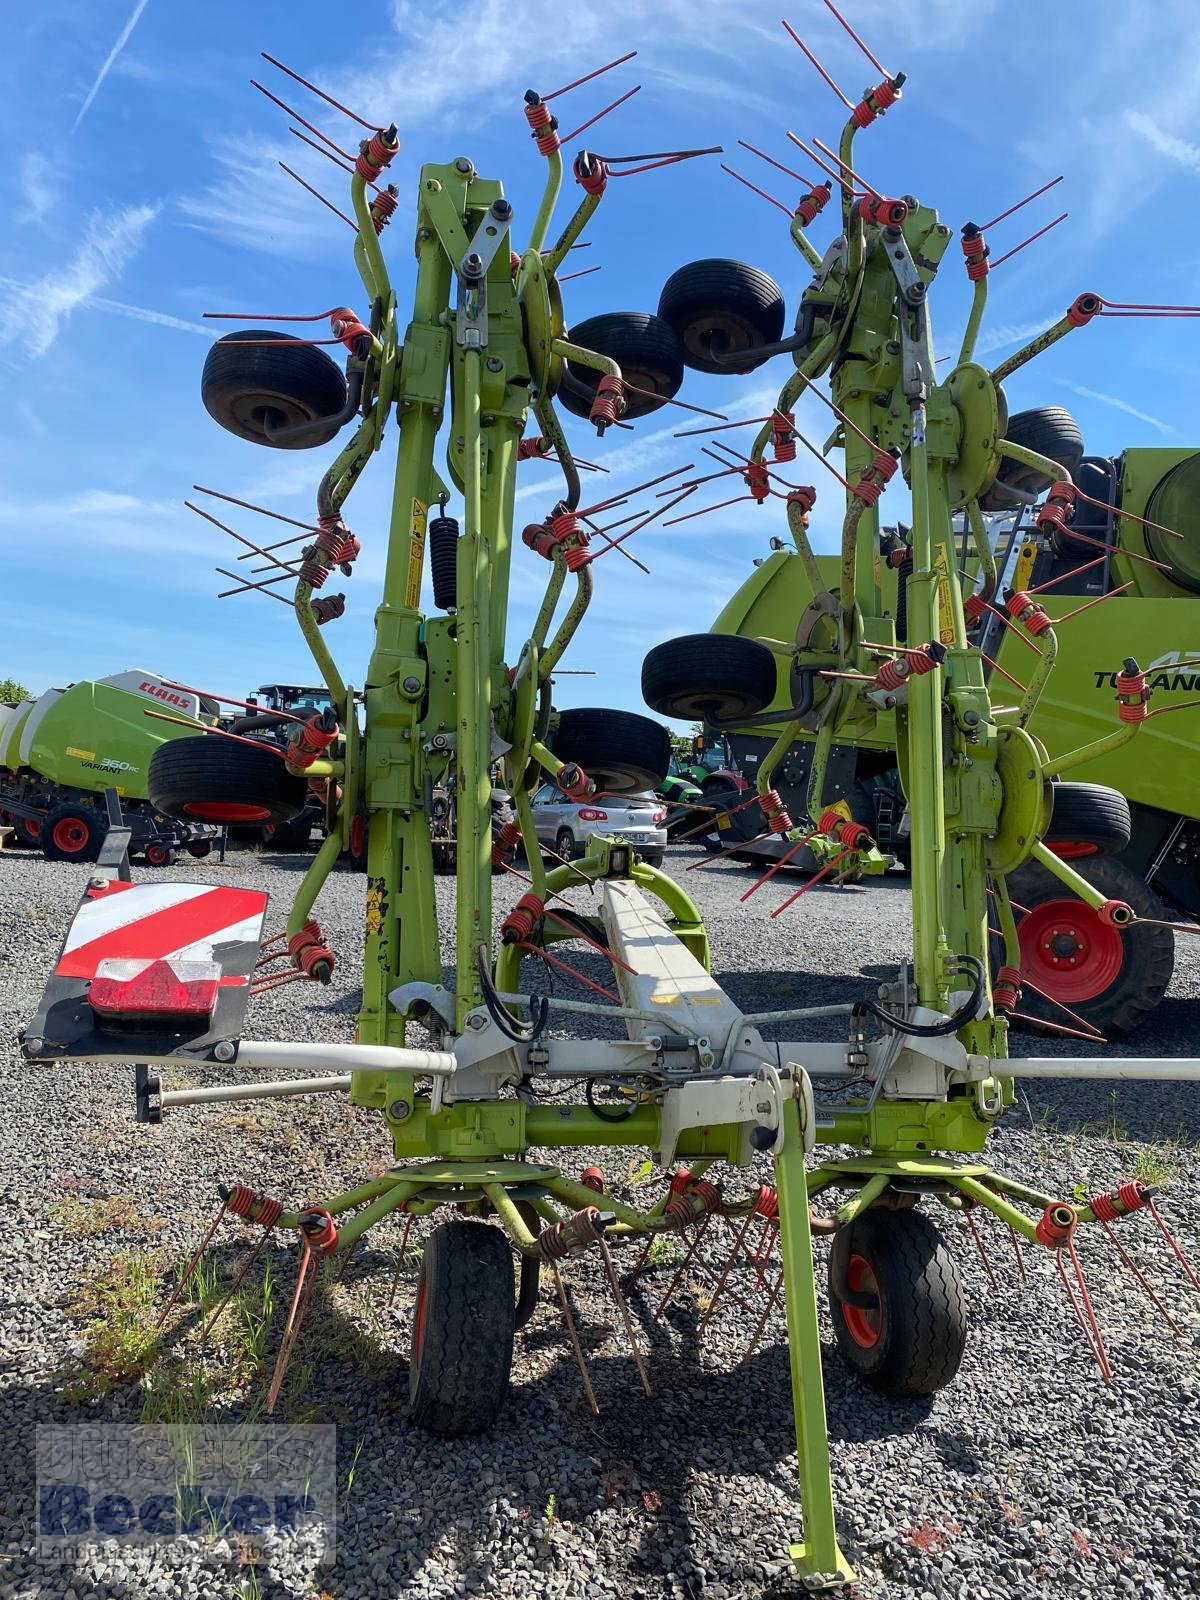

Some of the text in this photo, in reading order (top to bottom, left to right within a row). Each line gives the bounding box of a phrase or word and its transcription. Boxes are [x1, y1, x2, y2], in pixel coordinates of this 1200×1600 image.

[1095, 672, 1200, 690] TAN
[139, 681, 191, 709] CLAAS
[81, 760, 122, 774] VARIANT
